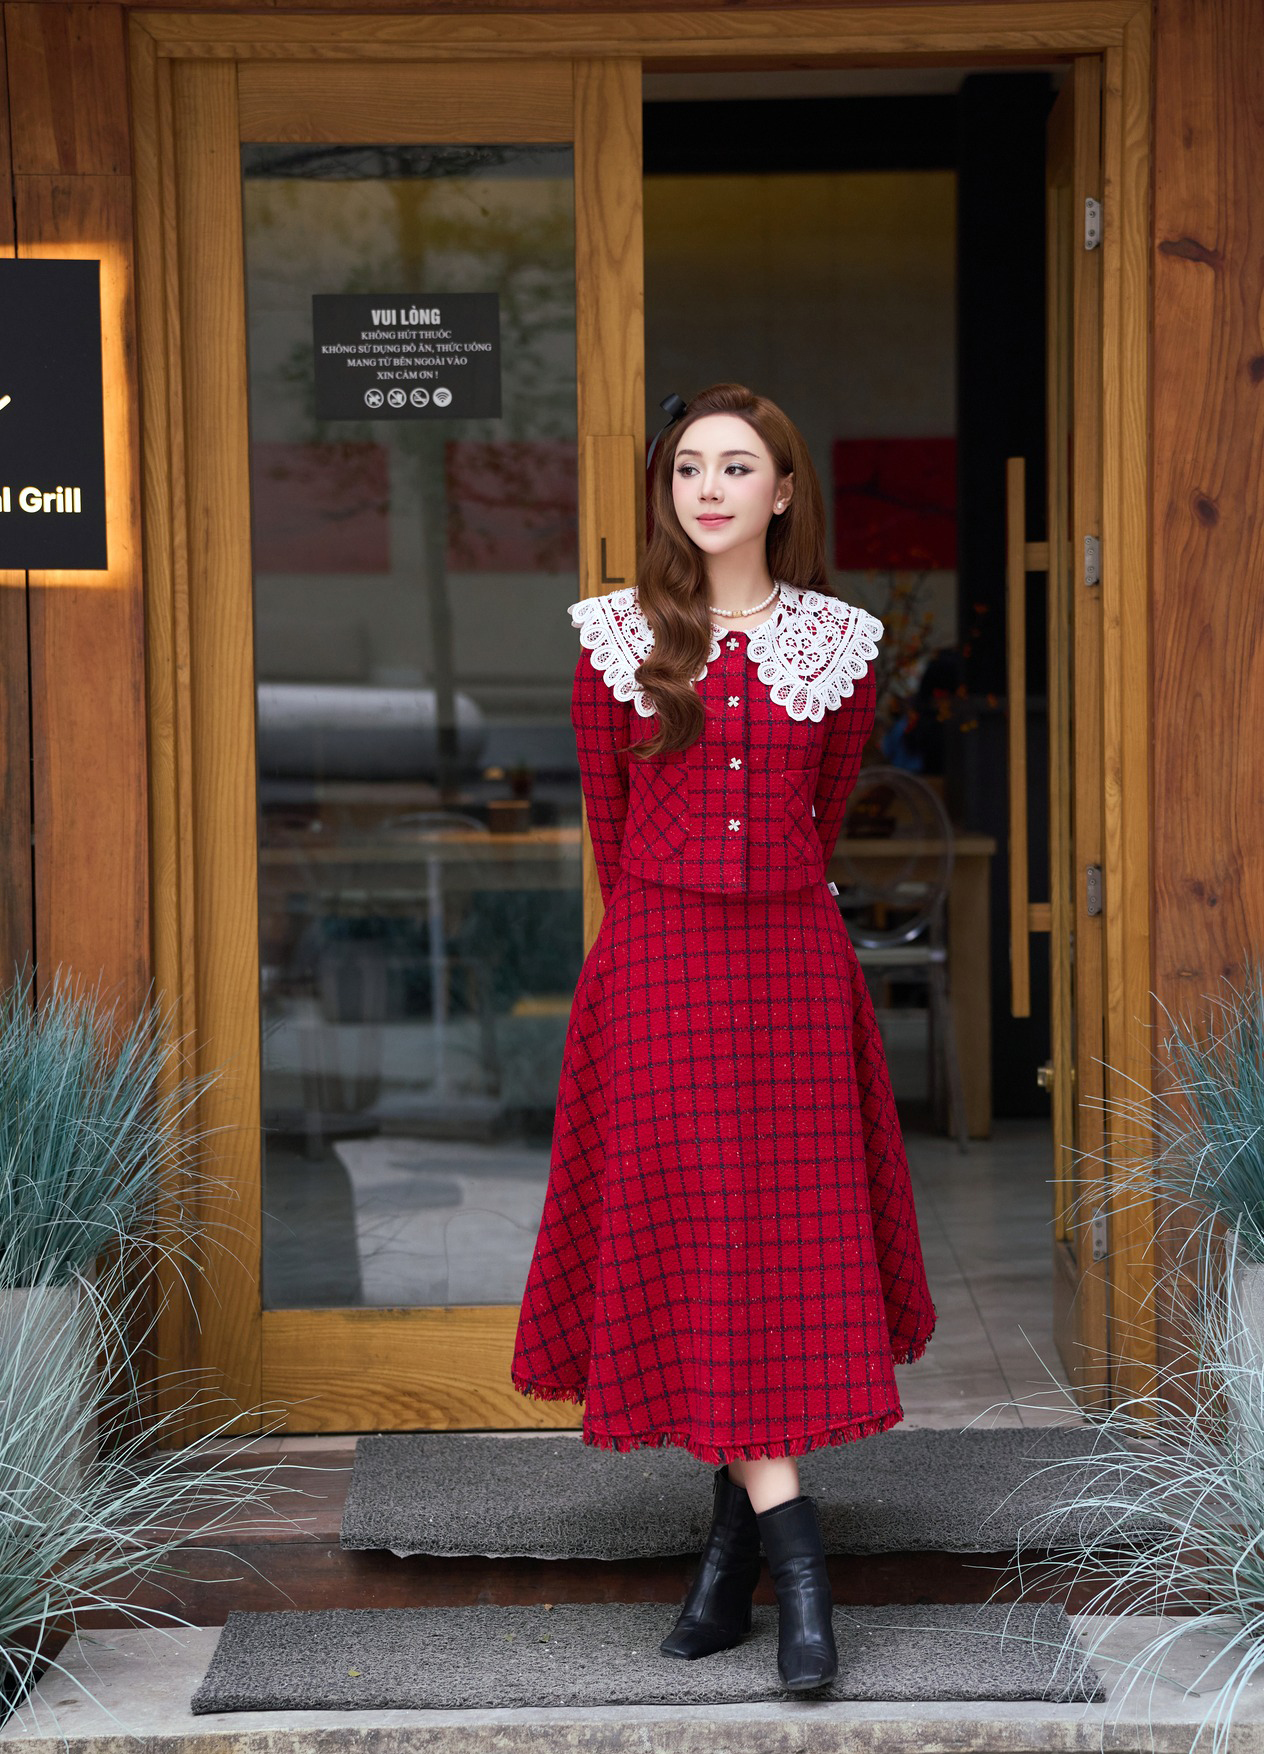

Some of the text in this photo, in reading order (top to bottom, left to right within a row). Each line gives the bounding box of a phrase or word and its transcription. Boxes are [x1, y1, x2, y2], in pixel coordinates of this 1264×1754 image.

[371, 305, 441, 326] VUI LÒNG
[361, 328, 452, 340] KHÔNG HÚT THUỐC
[321, 343, 357, 354] KHÔNG
[373, 344, 401, 354] DỤNG
[436, 341, 463, 352] THỨC
[464, 340, 492, 352] UỐNG
[347, 358, 377, 367] MANG
[393, 355, 412, 366] BÊN
[414, 355, 445, 366] NGOÀI
[446, 355, 468, 365] VÀO
[376, 371, 394, 380] XIN
[395, 369, 418, 379] CẢM
[0, 486, 82, 513] l Grill
